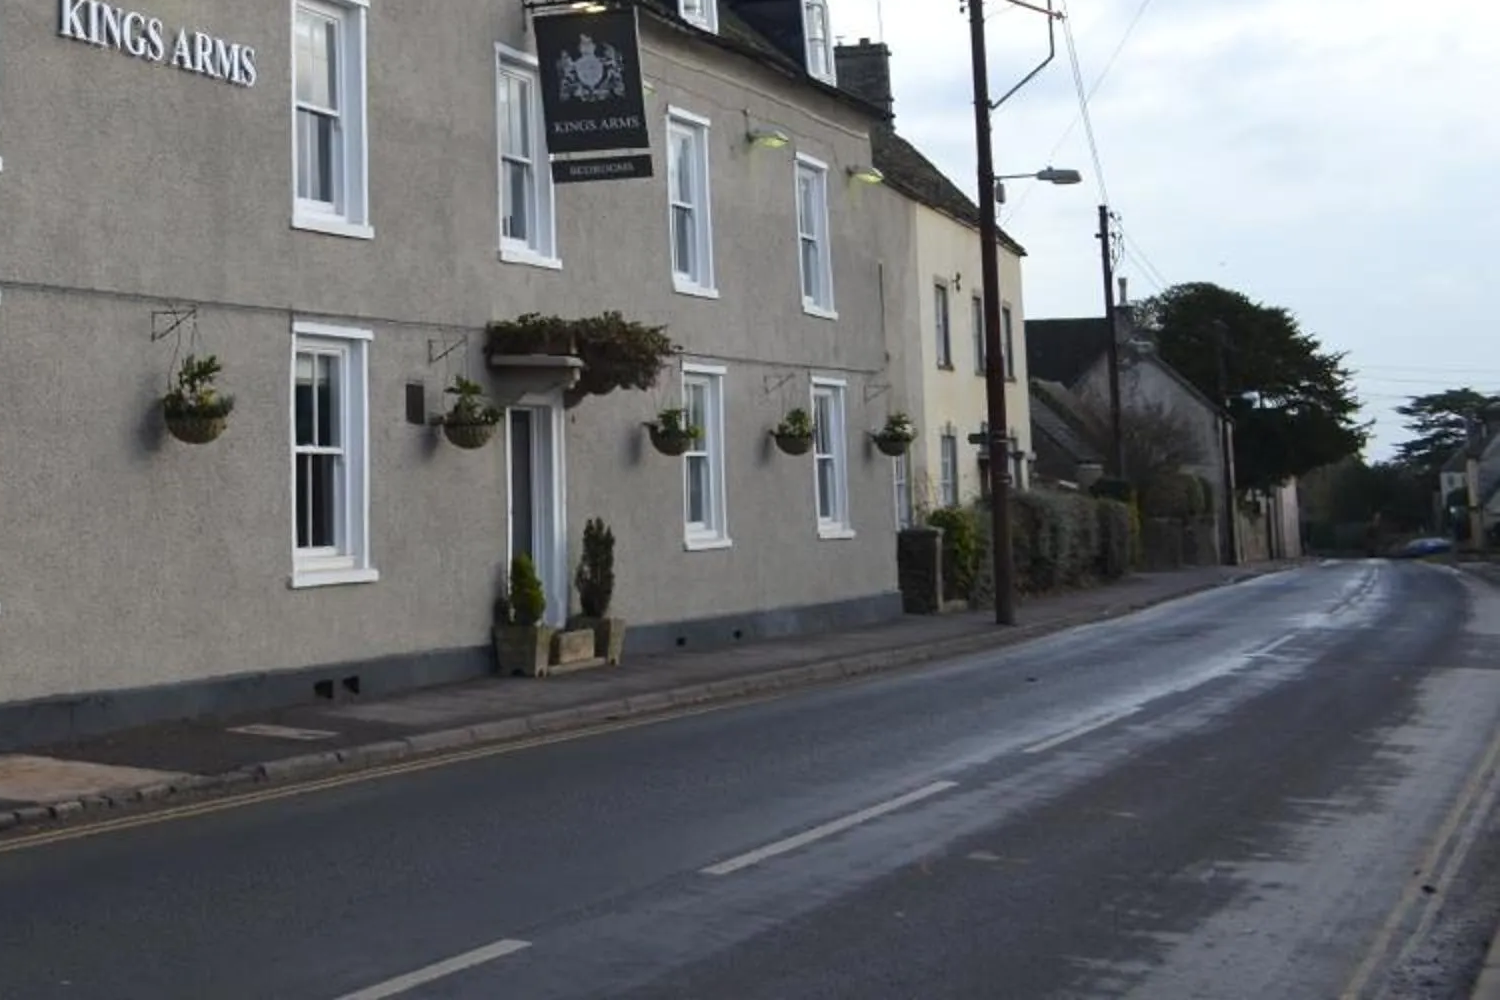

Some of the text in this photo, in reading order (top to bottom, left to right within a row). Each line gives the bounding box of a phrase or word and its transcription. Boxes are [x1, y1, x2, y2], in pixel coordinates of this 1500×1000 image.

[171, 27, 257, 88] ARMS
[553, 115, 640, 134] KINGS ARMS
